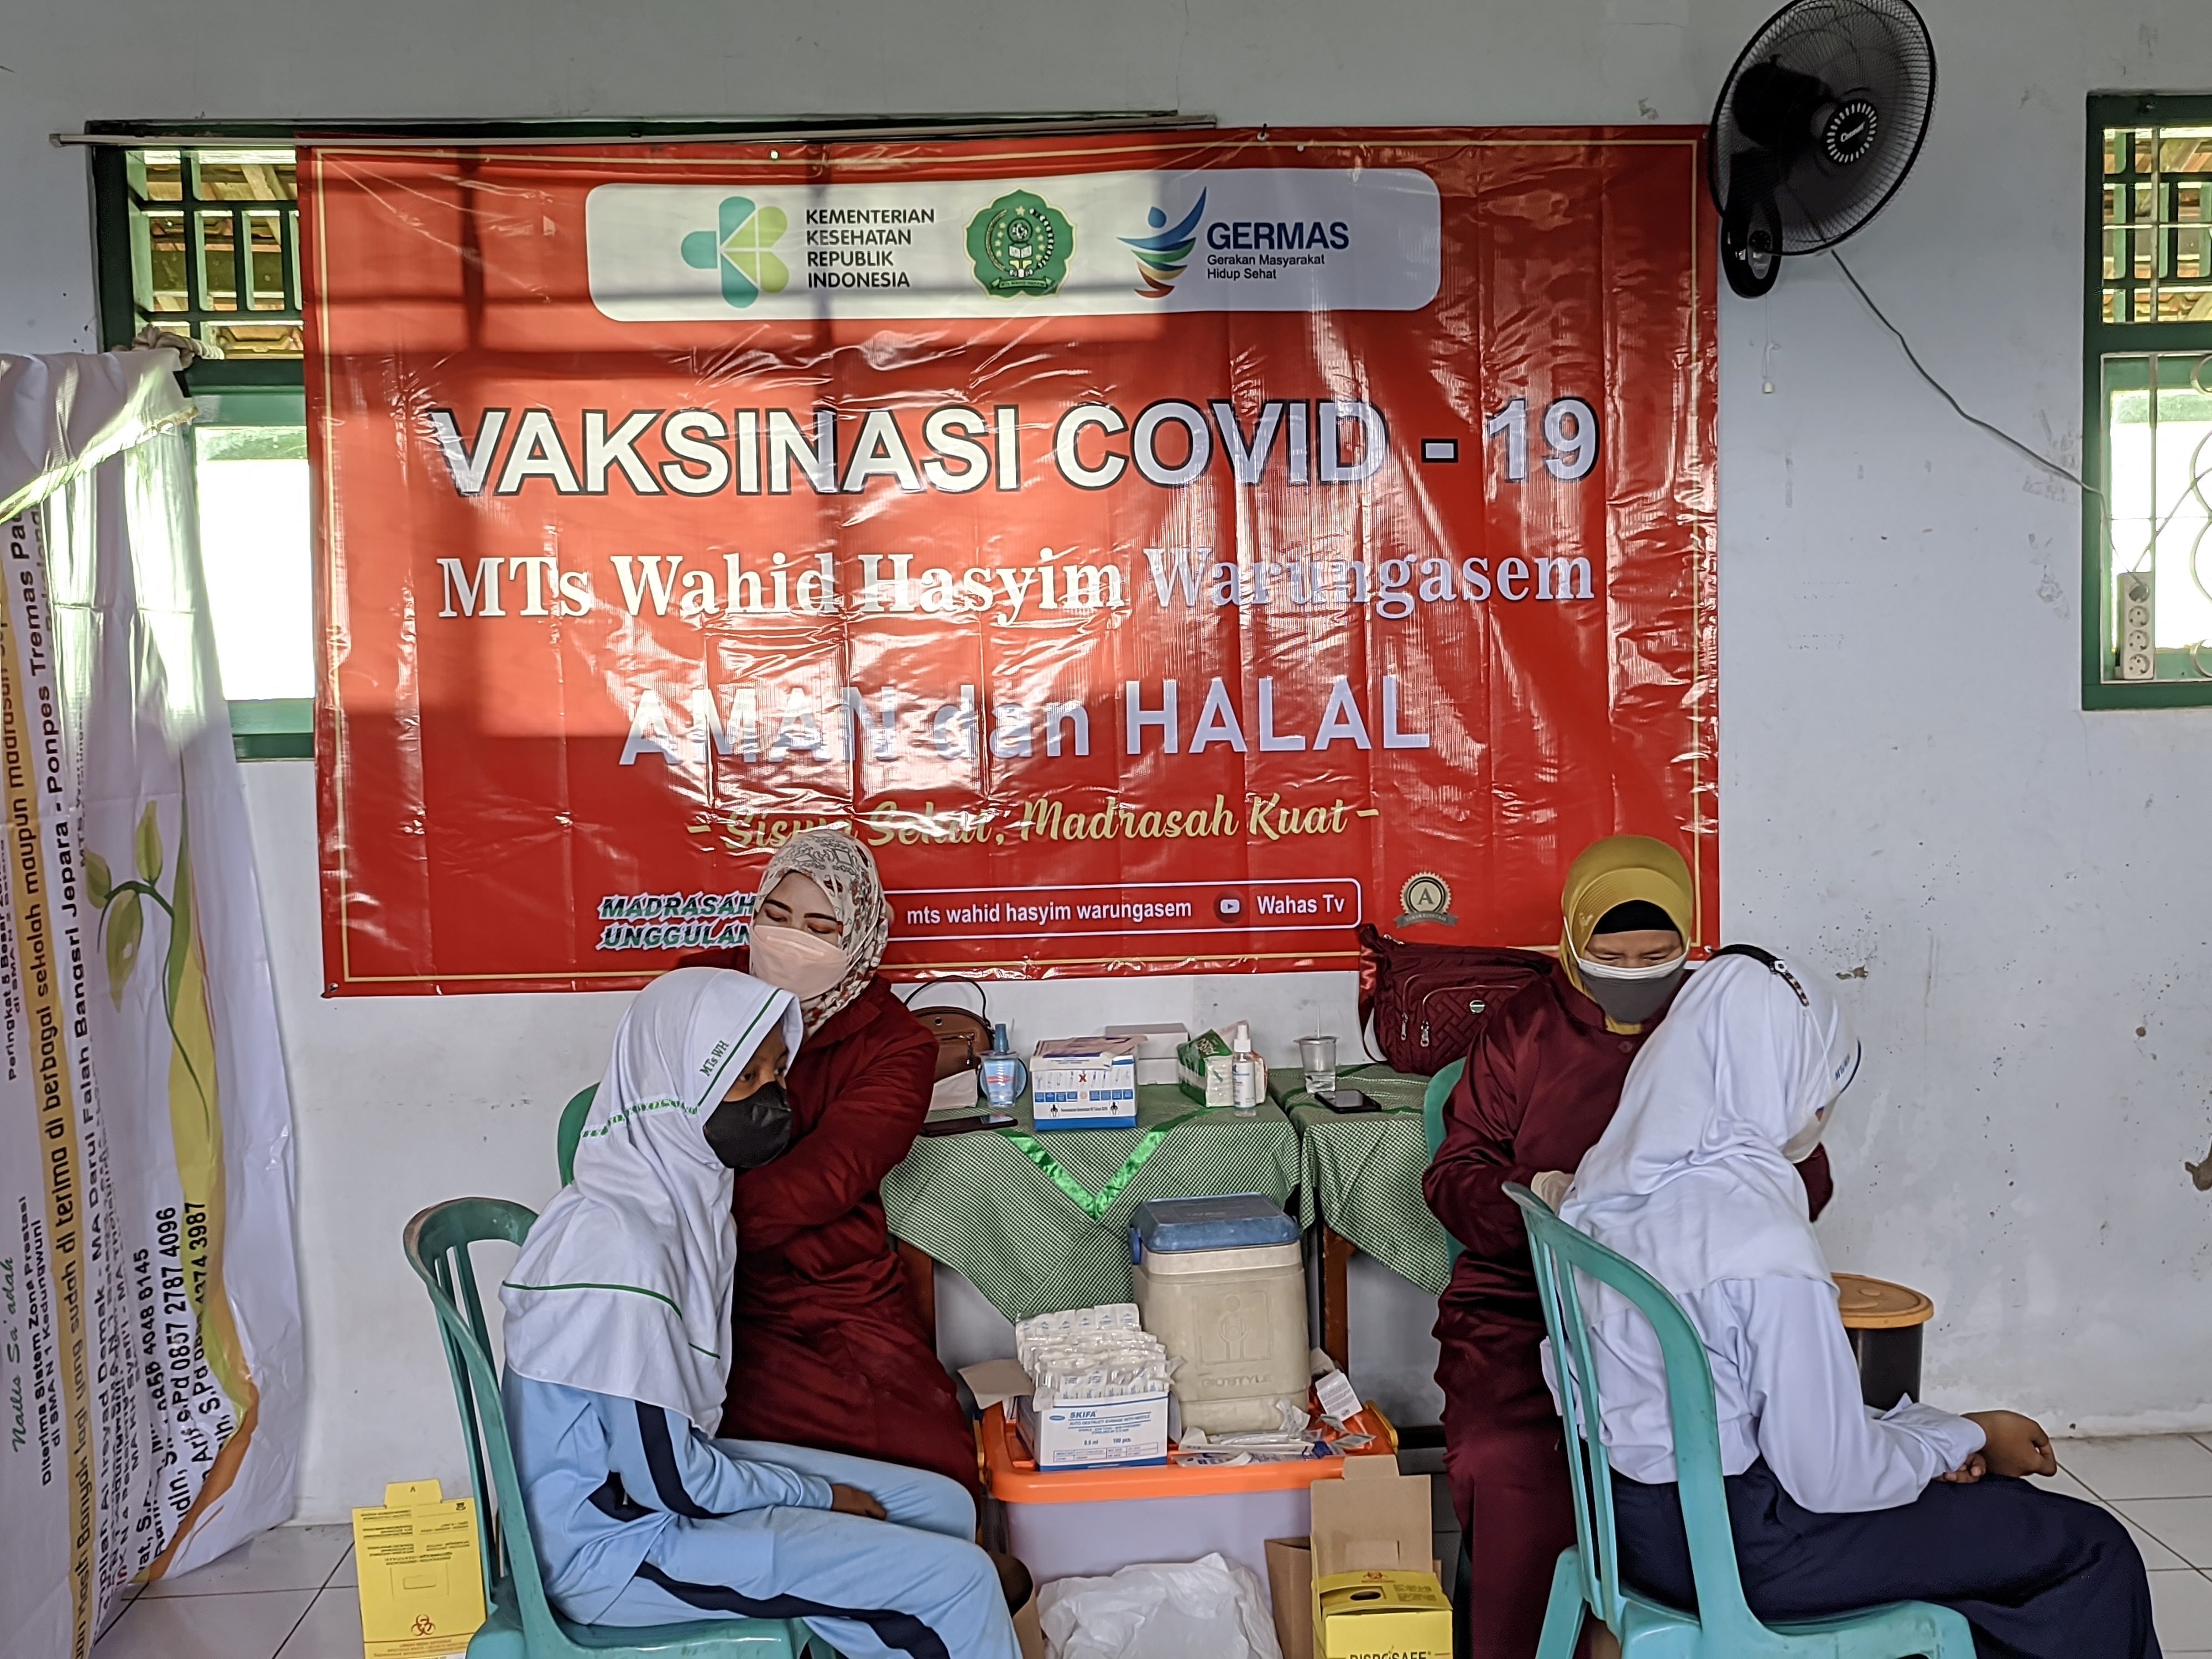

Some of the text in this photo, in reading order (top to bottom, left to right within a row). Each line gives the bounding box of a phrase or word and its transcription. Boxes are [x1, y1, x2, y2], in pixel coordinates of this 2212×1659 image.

[806, 208, 935, 225] KEMENTERIAN
[807, 229, 911, 245] KESEHATAN
[1207, 222, 1349, 249] GERMAS
[807, 250, 894, 267] REPUBLIK
[808, 272, 910, 288] INDONESIA
[1207, 254, 1325, 268] Gerakan Masyarakat
[1207, 268, 1277, 281] Hidup Sehat
[429, 397, 1601, 497] VAKSINASI COVID - 19
[437, 546, 1597, 627] MTs Wahid Hasyim Warungasem
[19, 570, 46, 677] Tremas
[35, 685, 62, 795] Ponpes
[619, 675, 1431, 766] AMAN dan HALAL
[1020, 794, 1239, 842] Madrasah
[1248, 791, 1348, 841] Kuat
[12, 797, 40, 895] maupun
[55, 821, 77, 918] Jepara
[599, 890, 757, 921] MADRASAH
[906, 901, 1193, 925] mts wahid hasyim warungasem
[1256, 893, 1345, 915] Wahas Tv
[1417, 887, 1435, 905] A
[25, 903, 49, 998] sekolah
[596, 920, 750, 950] UNGGULAN
[9, 947, 18, 991] SMA
[65, 927, 88, 1039] Bangsri
[14, 997, 21, 1014] di
[2, 989, 17, 1081] Peringkat
[36, 1005, 60, 1112] berbagai
[699, 1040, 730, 1077] MTs WH
[79, 1046, 94, 1125] Falah
[44, 1117, 65, 1140] di
[51, 1146, 74, 1226] terima
[85, 1131, 98, 1208] Darul
[56, 1231, 76, 1254] di
[91, 1212, 102, 1261] MA
[155, 1207, 181, 1258] 4096
[184, 1201, 207, 1251] 3987
[30, 1219, 51, 1340] Kedungwuni
[61, 1259, 81, 1334] sudah
[133, 1248, 153, 1300] 8145
[161, 1266, 186, 1315] 2787
[18, 1196, 52, 1486] Diterima Sistem Zona Prestasi
[94, 1284, 108, 1385] Demak
[140, 1305, 156, 1355] 4048
[165, 1322, 191, 1371] 0857
[44, 1360, 55, 1376] N
[71, 1338, 86, 1401] yang
[46, 1378, 59, 1425] SMA
[51, 1427, 61, 1447] di
[74, 1408, 90, 1455] lagi
[75, 1457, 92, 1549] Banyak
